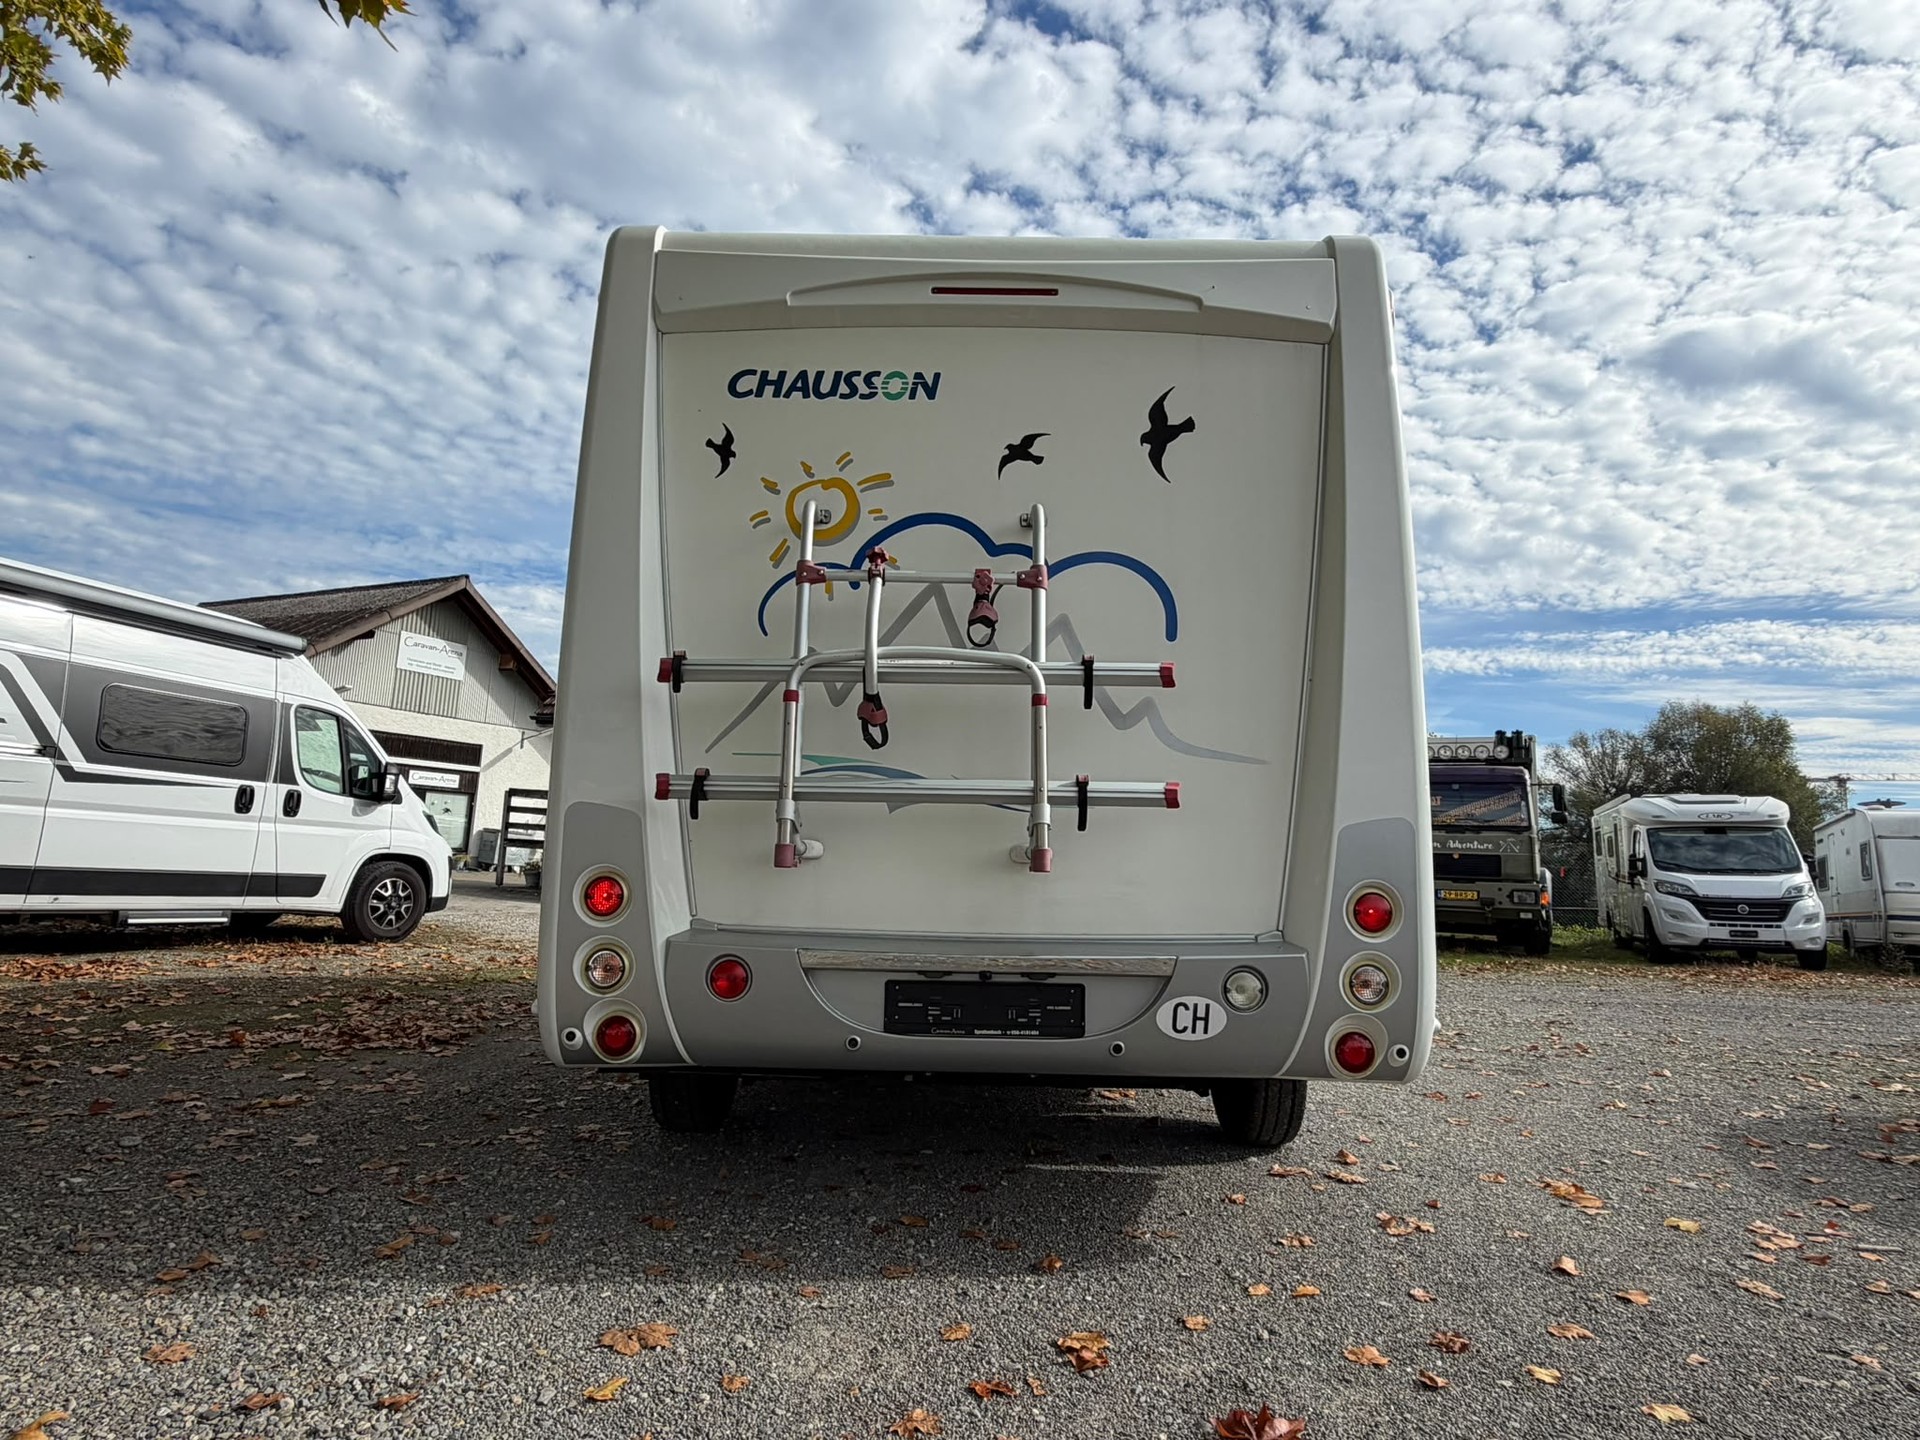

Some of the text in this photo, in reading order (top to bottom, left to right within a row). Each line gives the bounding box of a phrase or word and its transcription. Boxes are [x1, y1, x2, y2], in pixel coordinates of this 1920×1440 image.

[727, 369, 942, 401] CHAUSSON
[1446, 840, 1493, 849] Adventure
[1172, 1002, 1210, 1034] CH
